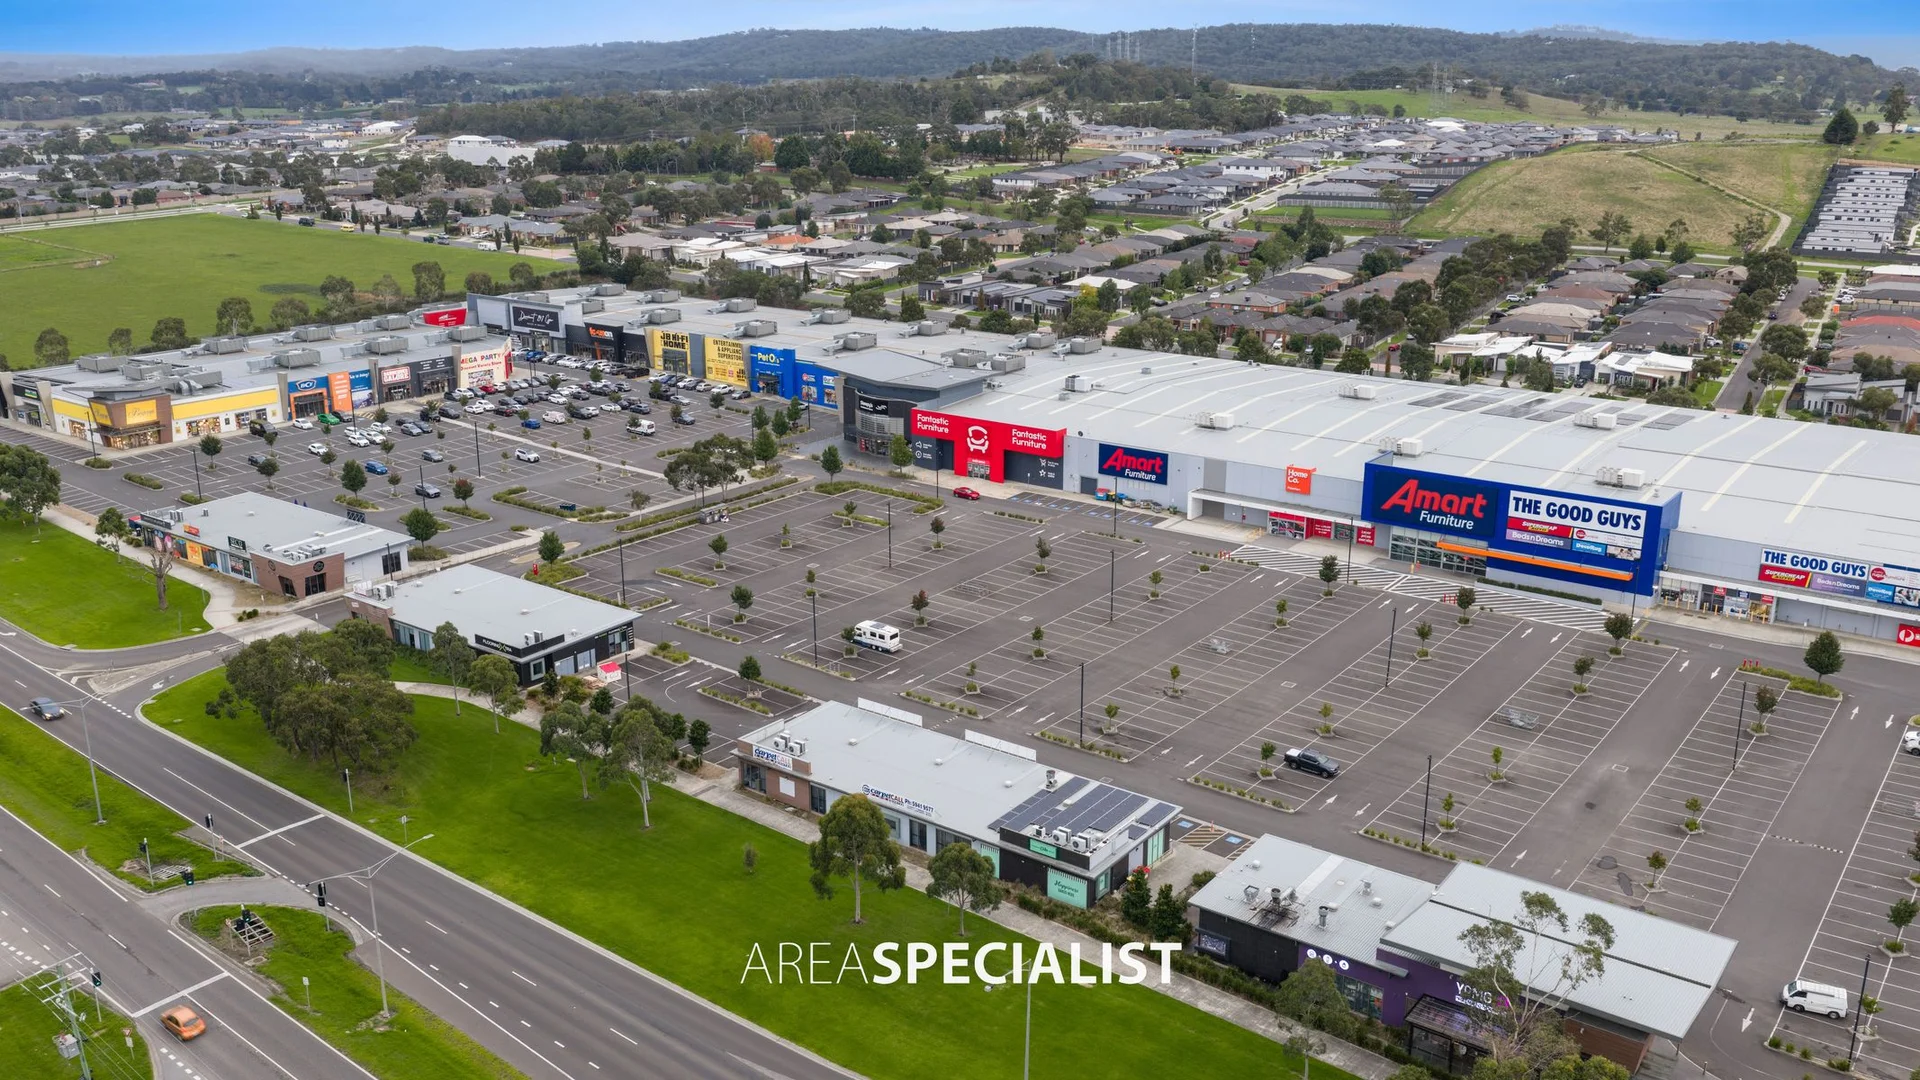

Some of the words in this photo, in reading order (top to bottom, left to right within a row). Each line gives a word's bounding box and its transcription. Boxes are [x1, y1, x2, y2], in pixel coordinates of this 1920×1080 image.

[660, 332, 671, 341] JB
[663, 340, 686, 350] HOME
[481, 353, 502, 361] PARTY
[917, 413, 950, 426] Fantastic
[917, 422, 950, 434] Furniture
[1012, 428, 1047, 441] Fantastic
[1012, 437, 1047, 450] Furniture
[1102, 447, 1163, 474] Amart
[1124, 468, 1157, 481] Furniture
[1287, 469, 1309, 479] Home
[1287, 476, 1300, 484] Co.
[1381, 479, 1488, 519] Amart
[1419, 510, 1474, 530] Furniture
[1512, 496, 1542, 516] THE
[1545, 502, 1593, 523] GOOD
[1597, 509, 1642, 531] GUYS
[1512, 531, 1530, 541] Beds
[1535, 536, 1564, 546] Dreams
[1763, 550, 1787, 565] THE
[1790, 555, 1828, 571] GOOD
[1831, 561, 1867, 578] GUYS
